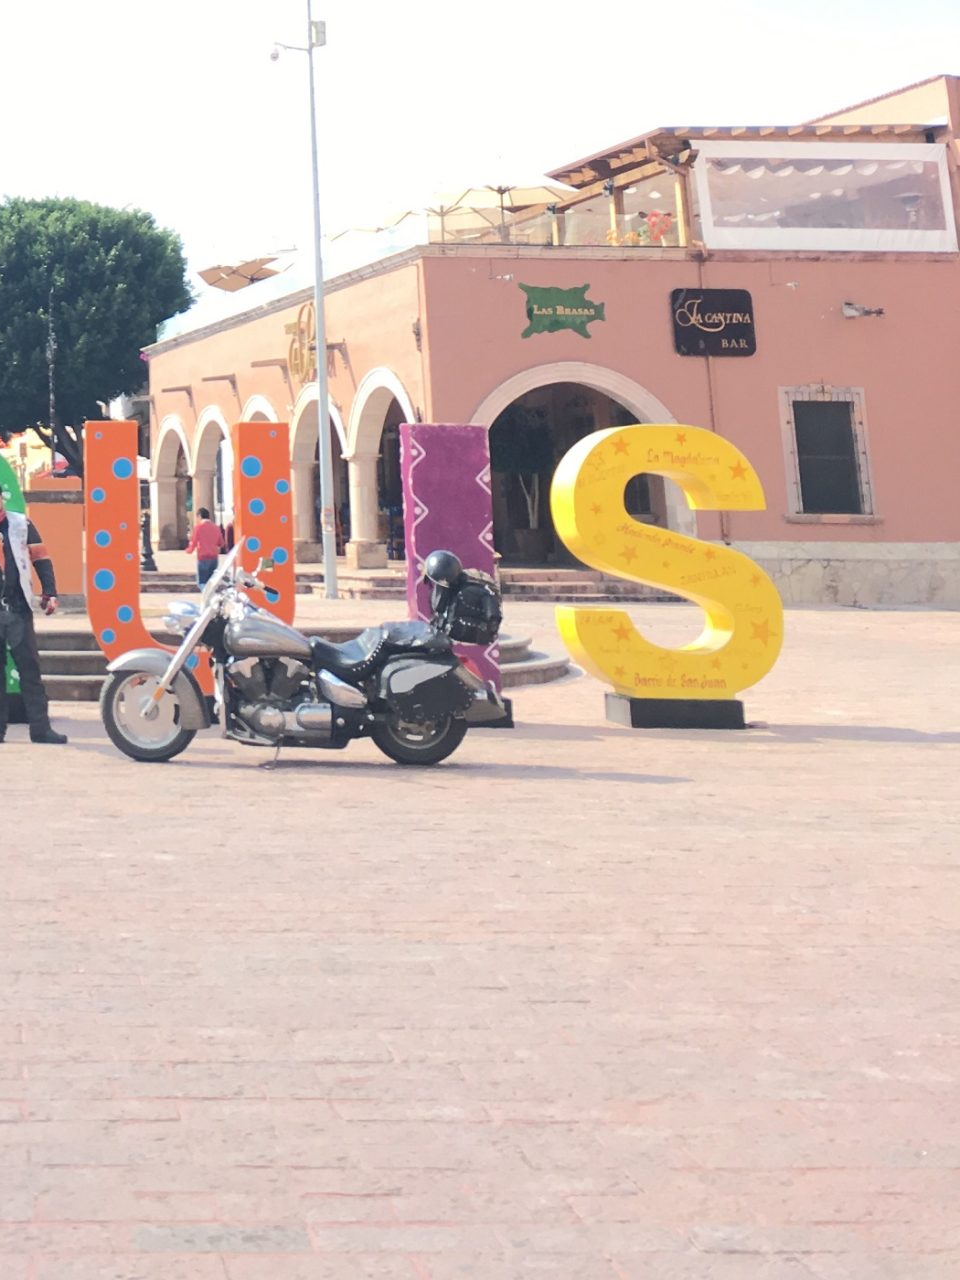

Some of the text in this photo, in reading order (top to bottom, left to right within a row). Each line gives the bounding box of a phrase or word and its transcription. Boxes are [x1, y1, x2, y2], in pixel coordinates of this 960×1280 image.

[533, 304, 595, 316] LAS BRASAS
[704, 312, 751, 324] CANTINA
[721, 339, 748, 349] BAR
